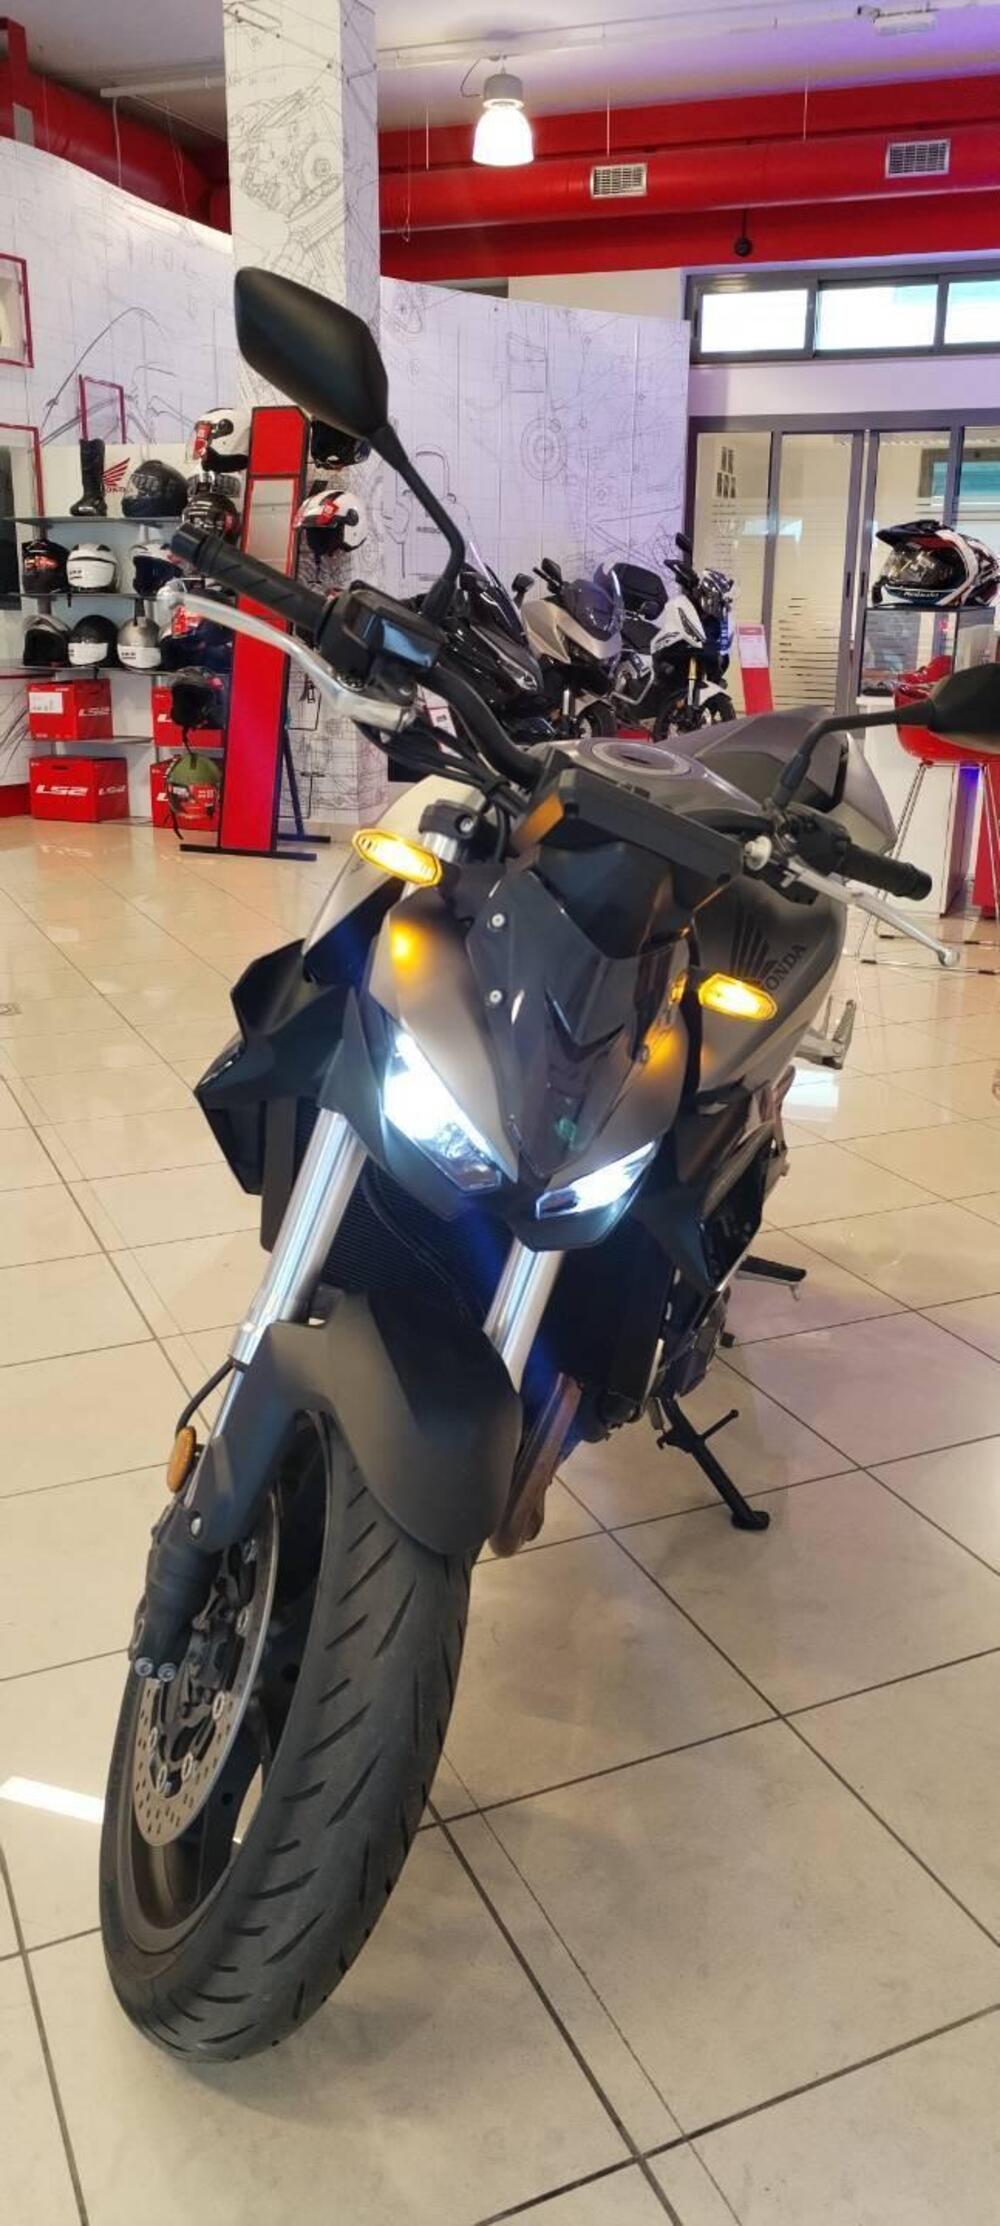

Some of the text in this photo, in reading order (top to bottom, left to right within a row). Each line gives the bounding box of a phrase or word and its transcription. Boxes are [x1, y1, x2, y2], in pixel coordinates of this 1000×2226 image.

[78, 707, 110, 717] LS2
[35, 784, 88, 797] LS2
[764, 944, 807, 991] ONDA
